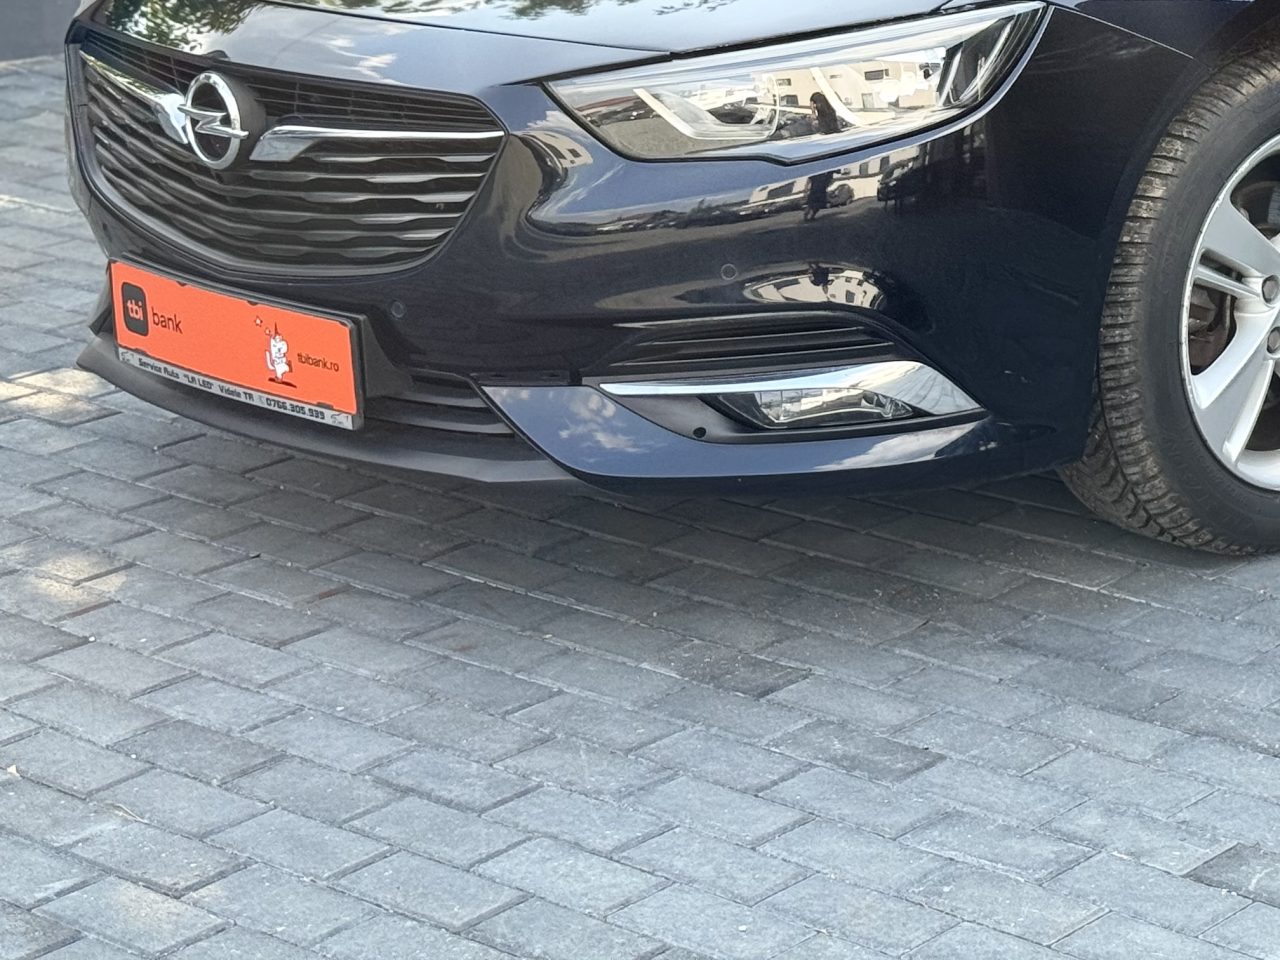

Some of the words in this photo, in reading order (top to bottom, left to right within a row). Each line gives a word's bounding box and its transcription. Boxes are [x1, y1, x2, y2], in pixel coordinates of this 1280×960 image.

[127, 299, 143, 321] tbi
[151, 306, 183, 334] bank
[138, 357, 162, 374] Service
